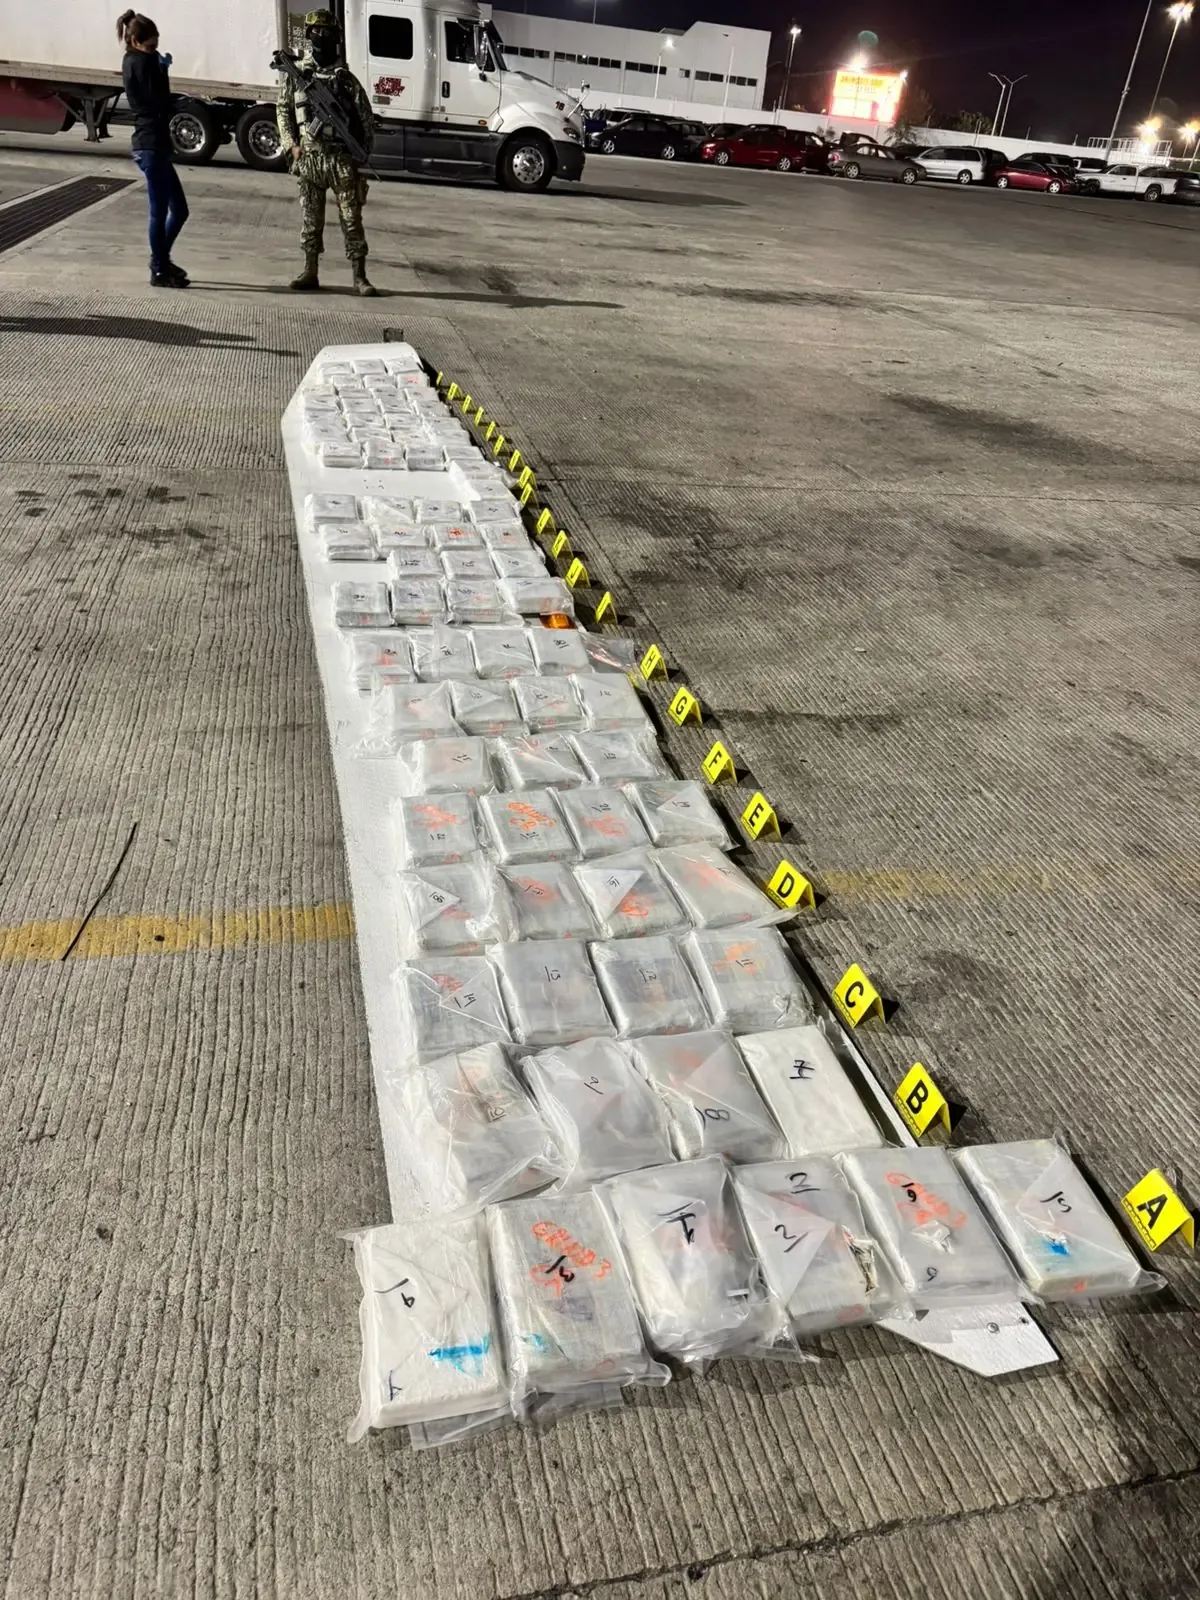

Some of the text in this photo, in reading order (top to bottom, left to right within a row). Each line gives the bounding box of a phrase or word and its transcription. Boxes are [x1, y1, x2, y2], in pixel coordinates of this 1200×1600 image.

[644, 650, 656, 670] H
[675, 696, 688, 715] G
[708, 750, 723, 768] F
[748, 802, 764, 827] E
[776, 871, 795, 898] D
[844, 981, 864, 1008] C
[906, 1079, 928, 1115] B
[1136, 1193, 1168, 1230] A
